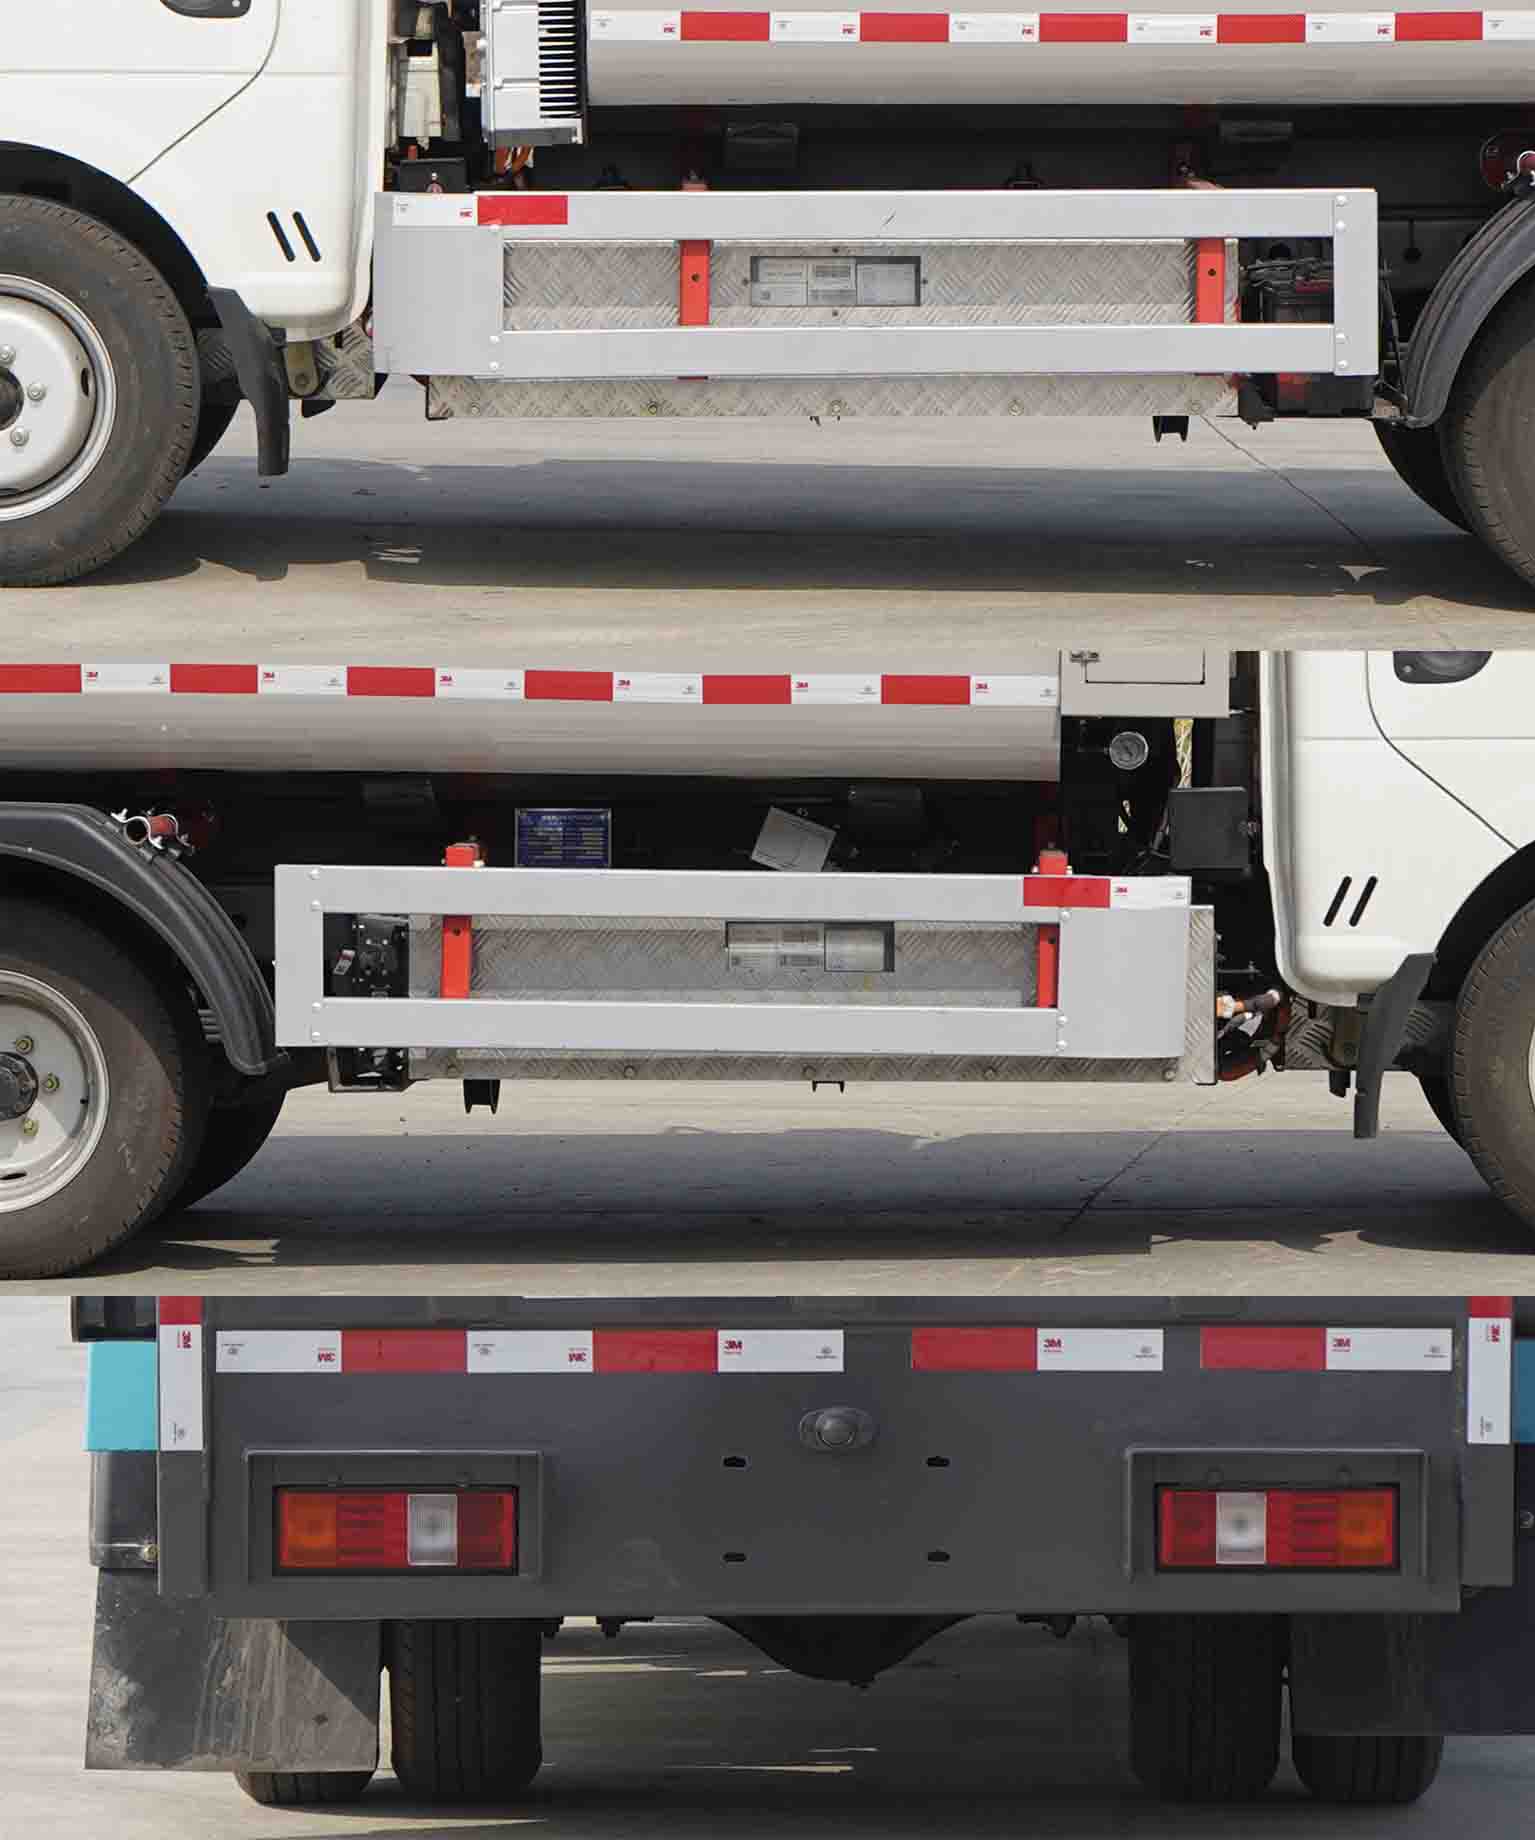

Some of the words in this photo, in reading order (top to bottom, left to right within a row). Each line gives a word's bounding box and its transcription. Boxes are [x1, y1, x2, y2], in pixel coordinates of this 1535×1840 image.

[724, 1340, 743, 1349] 3M
[1044, 1339, 1061, 1348] 3M
[1333, 1338, 1351, 1347] 3M
